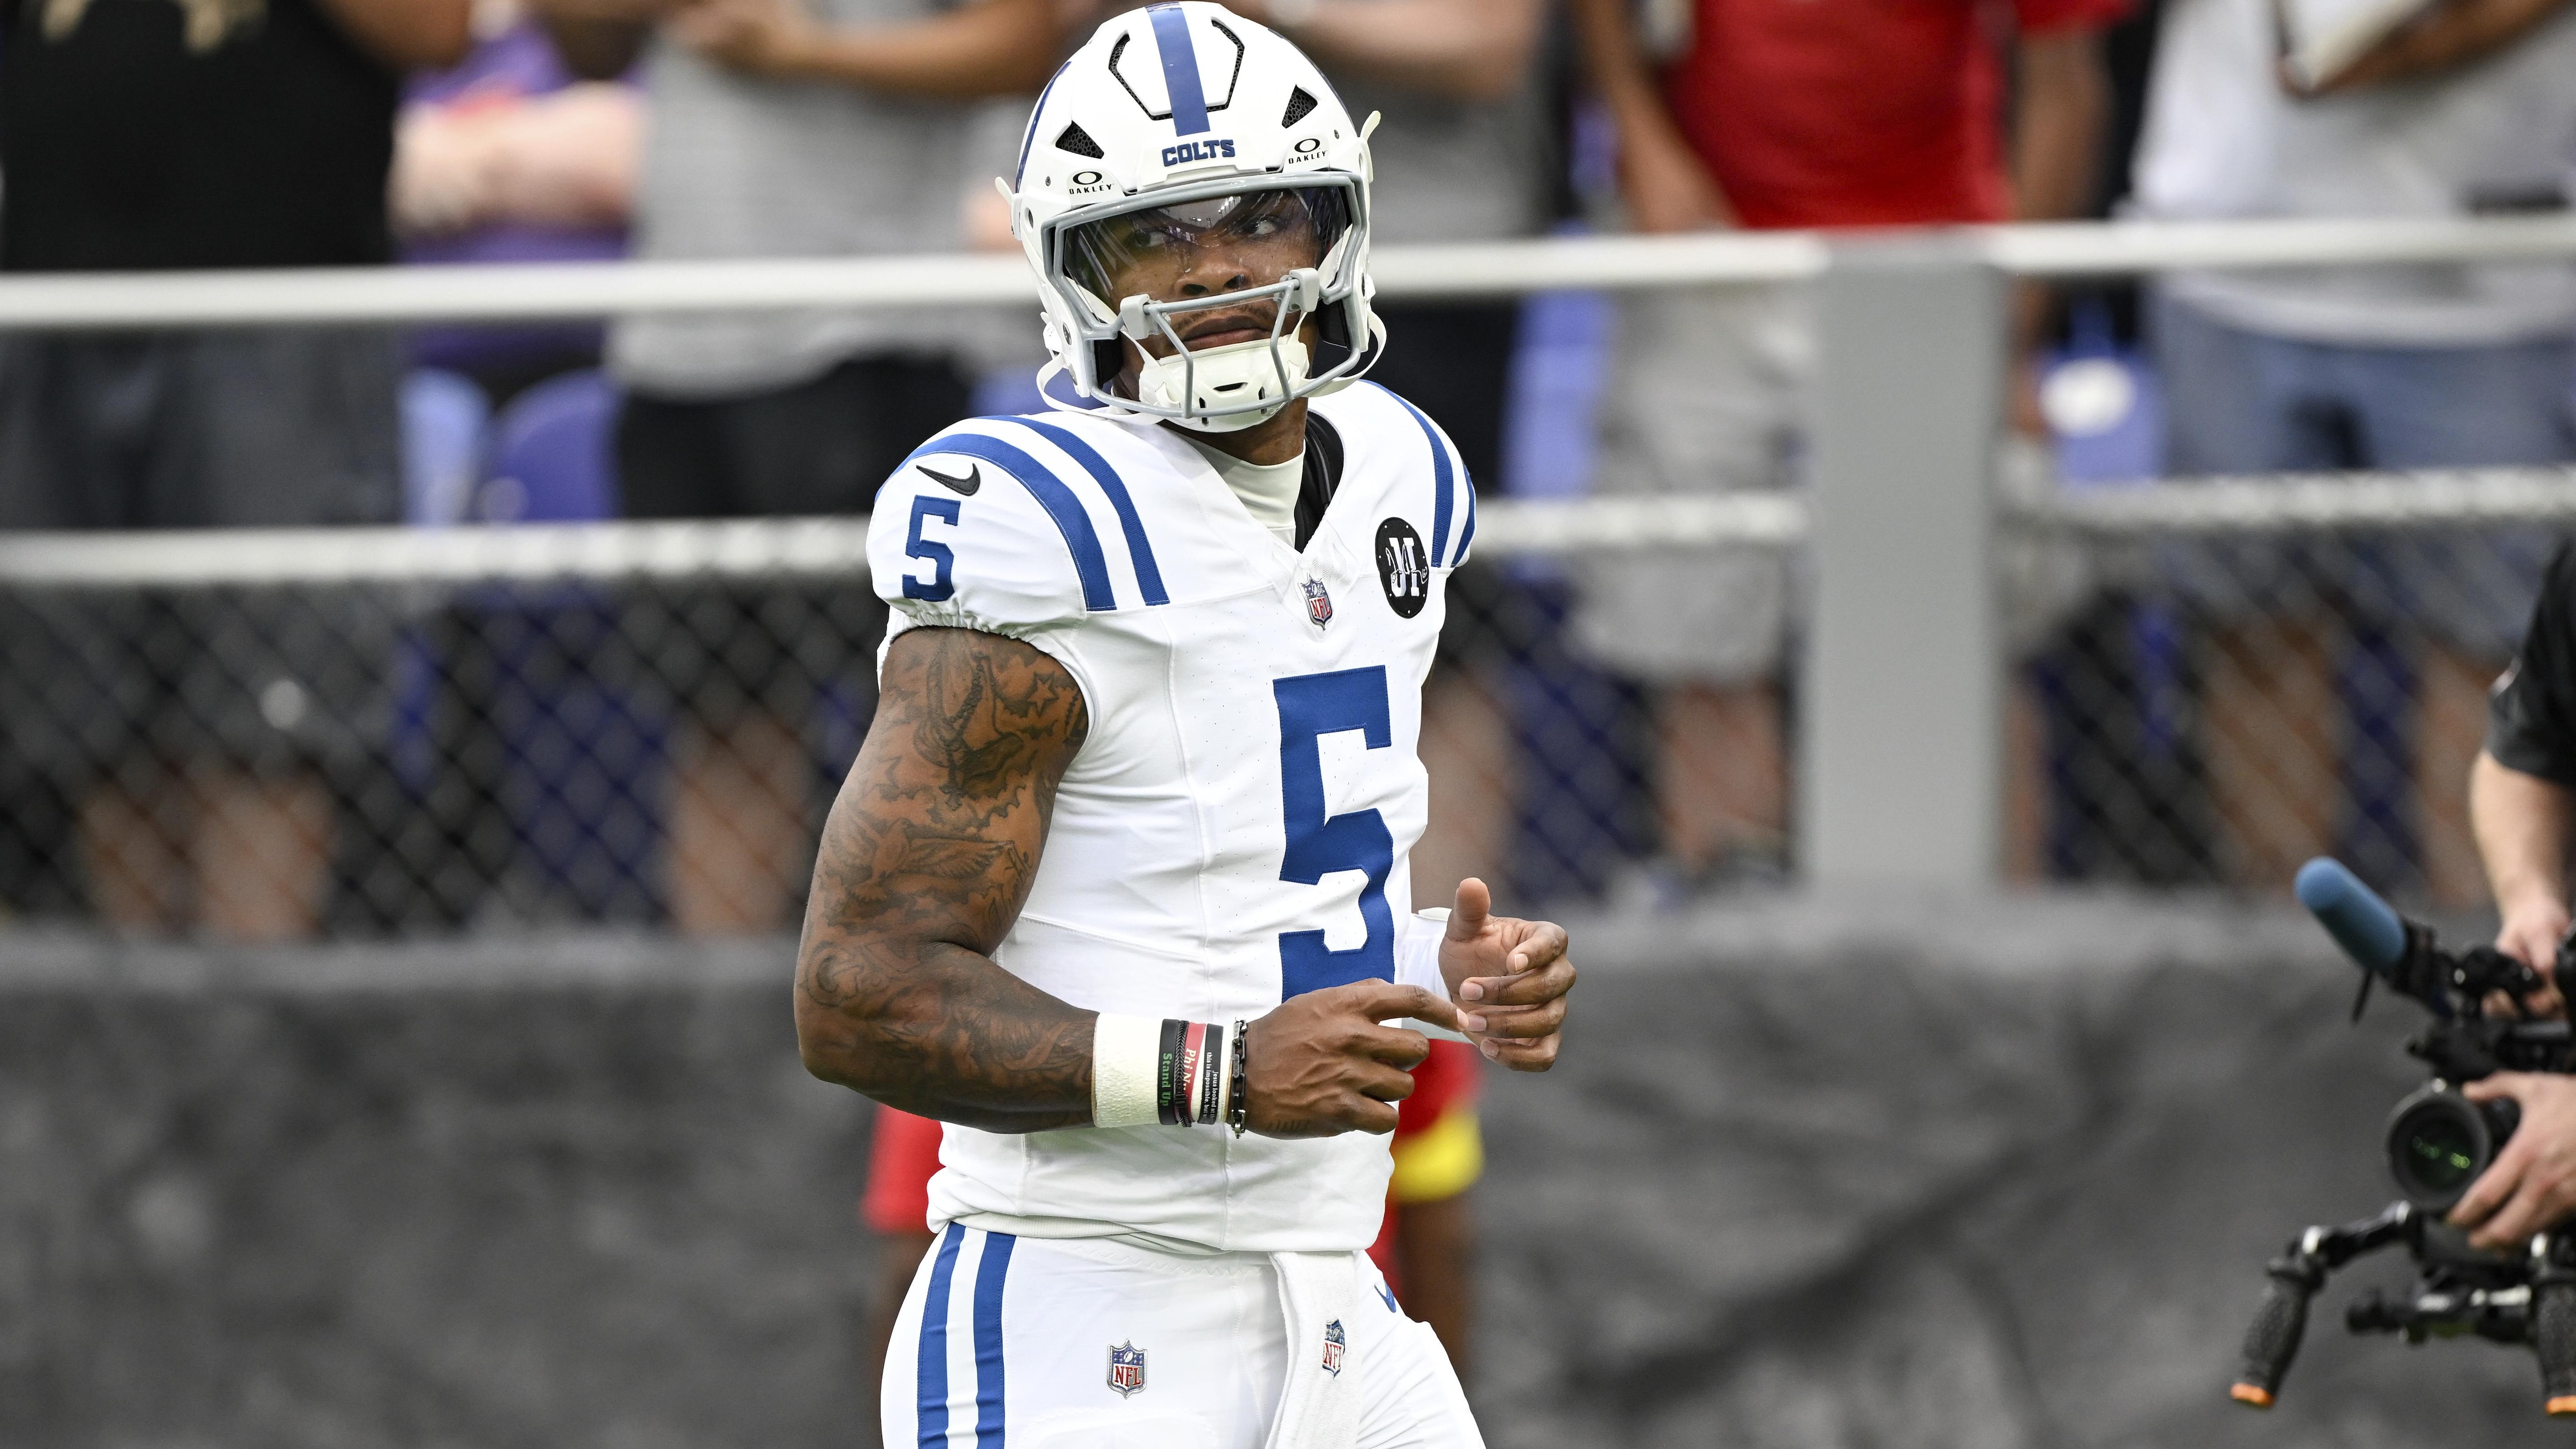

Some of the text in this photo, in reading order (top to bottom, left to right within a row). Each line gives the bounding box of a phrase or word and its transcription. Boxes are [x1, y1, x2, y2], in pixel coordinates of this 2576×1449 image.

[1162, 139, 1235, 167] COLTS
[1289, 150, 1326, 164] OAKLEY
[1069, 184, 1112, 195] OAKLEY
[902, 495, 961, 602] 5
[1310, 598, 1331, 619] NFL
[1272, 665, 1395, 1004] 5
[1183, 1048, 1197, 1070] Phi
[1160, 1053, 1173, 1106] Stand Up
[1114, 1366, 1141, 1388] NFL
